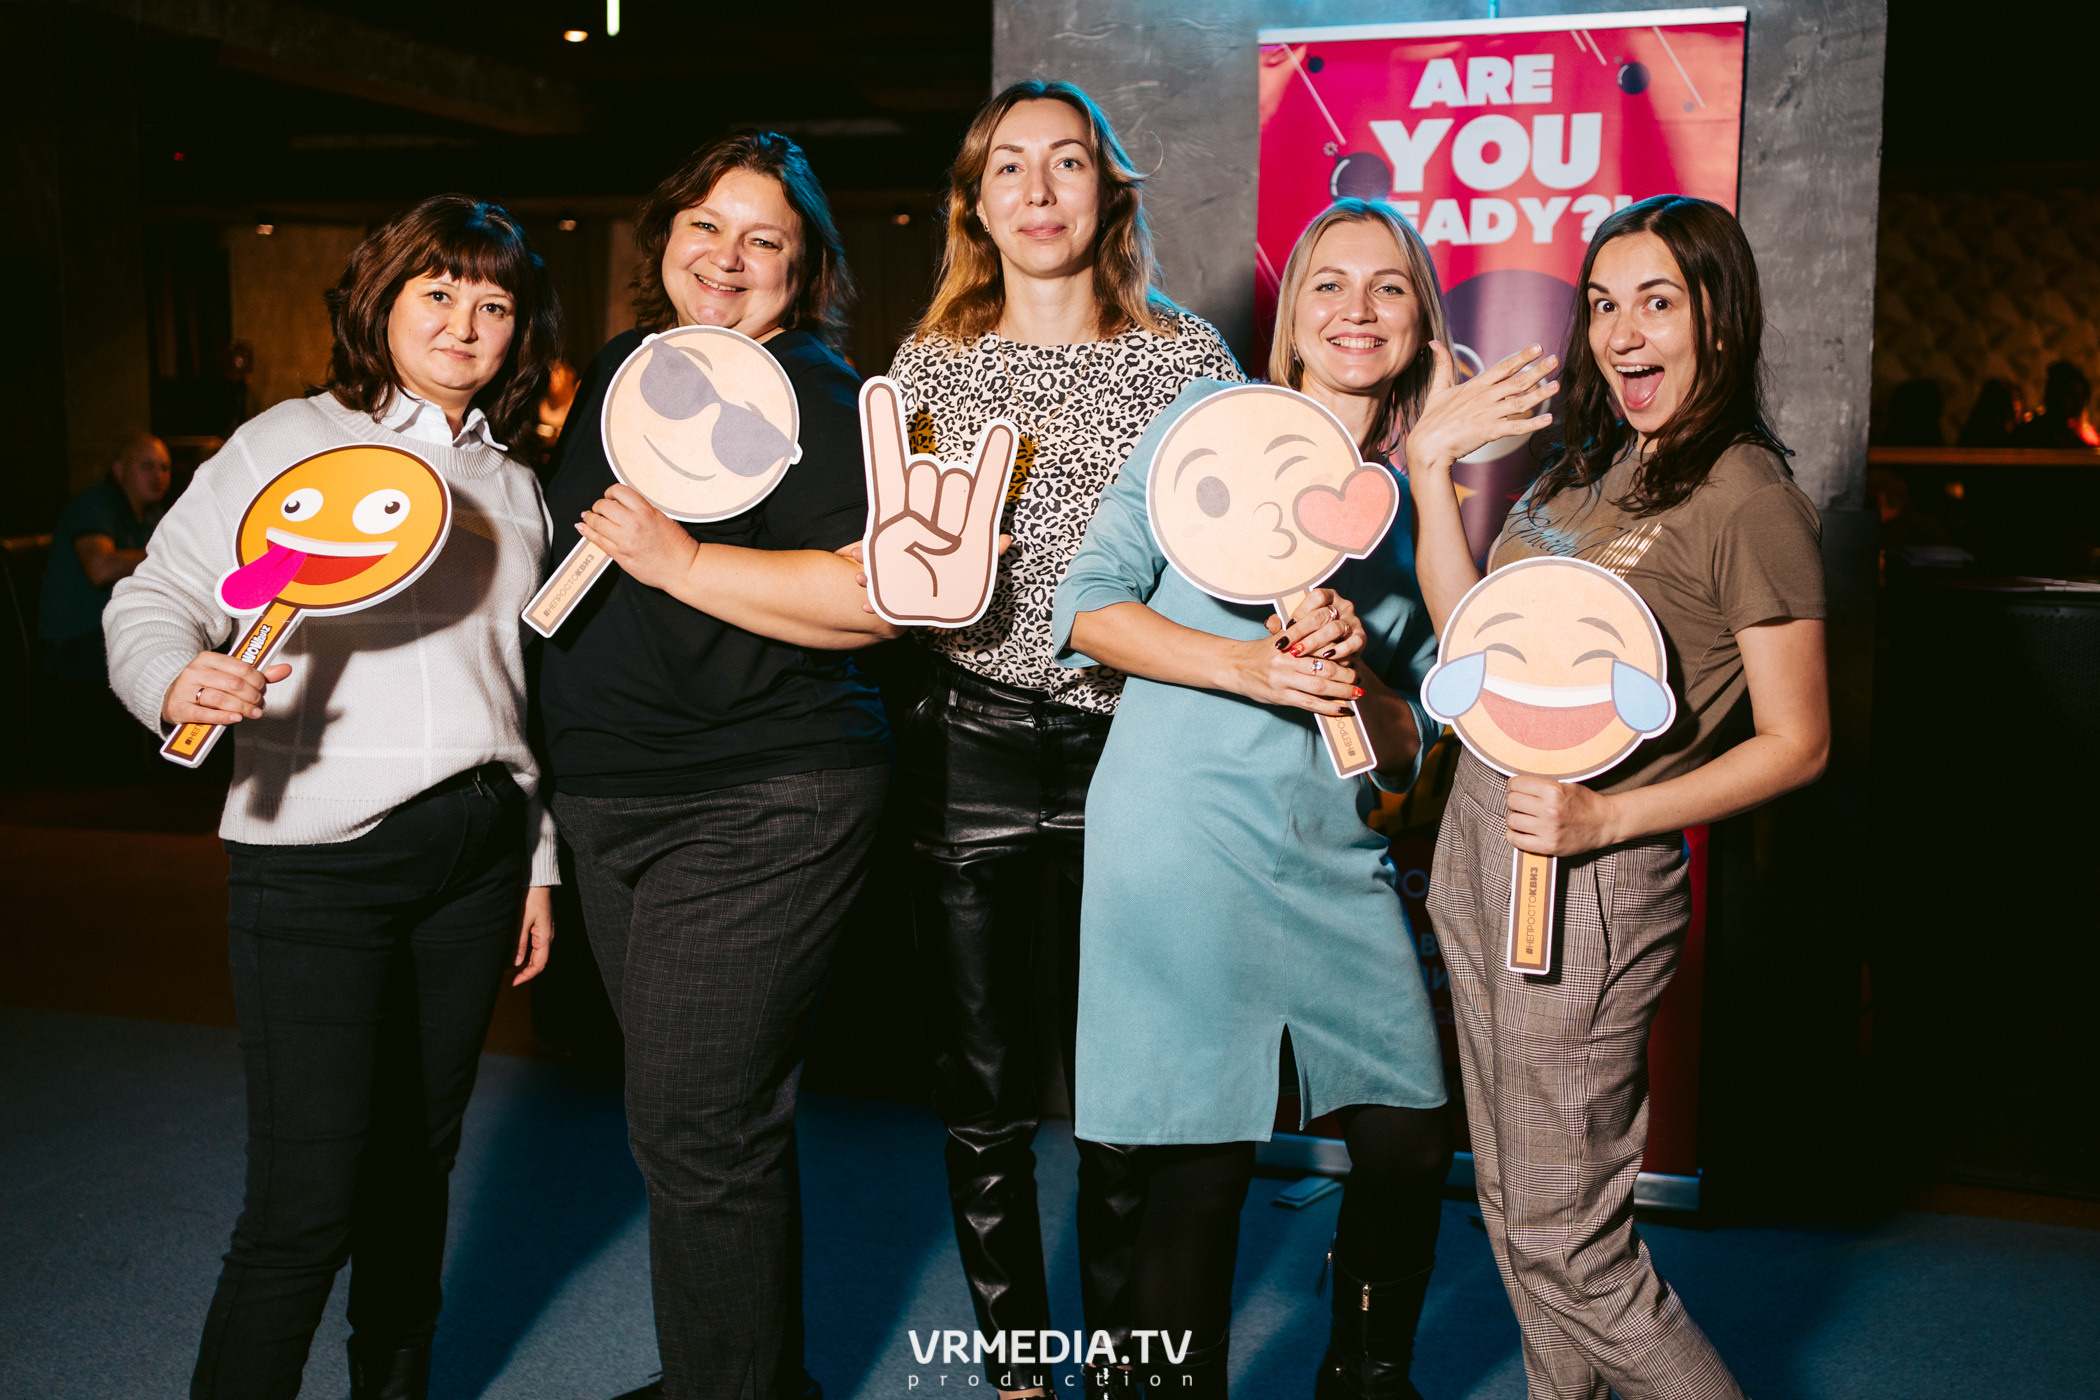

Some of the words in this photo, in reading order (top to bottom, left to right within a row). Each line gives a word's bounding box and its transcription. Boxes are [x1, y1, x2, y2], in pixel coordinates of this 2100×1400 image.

[1410, 54, 1554, 109] ARE
[1369, 112, 1602, 193] YOU
[543, 553, 595, 617] #НЕПРОСТОКВИЗ
[1525, 866, 1539, 955] #НЕПРОСТОКВИЗ
